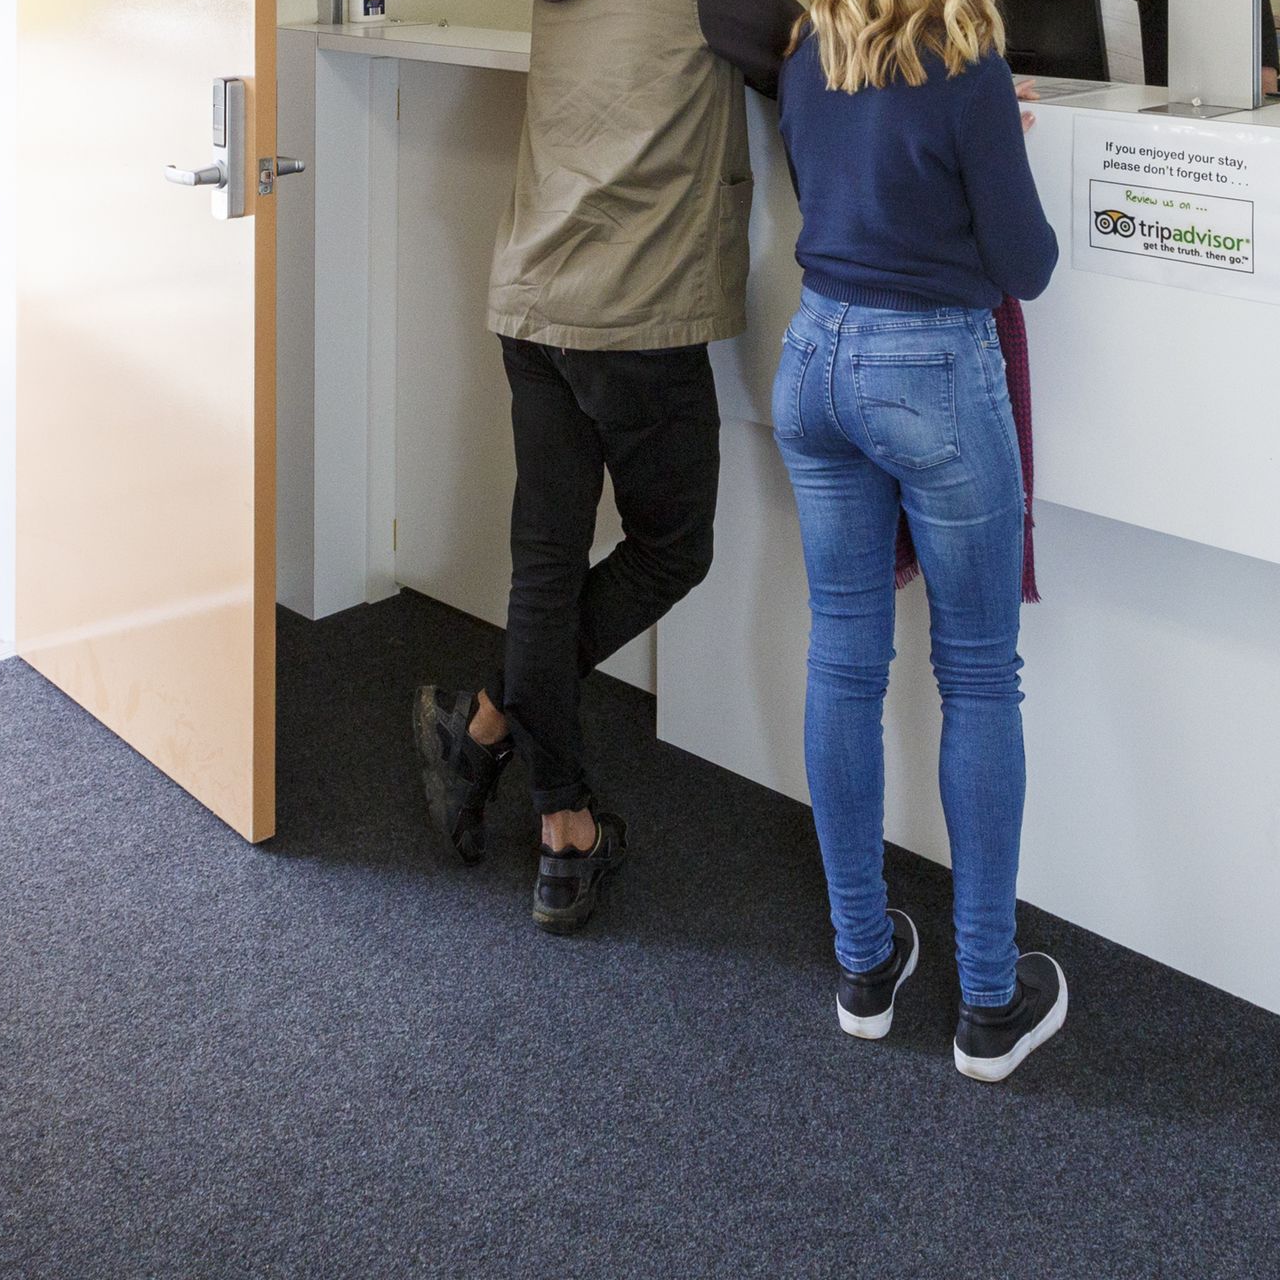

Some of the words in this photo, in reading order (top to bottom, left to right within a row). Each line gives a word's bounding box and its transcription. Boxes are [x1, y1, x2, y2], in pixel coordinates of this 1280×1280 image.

[1105, 141, 1113, 152] If
[1115, 145, 1136, 156] you
[1139, 147, 1185, 162] enjoyed
[1188, 152, 1215, 164] your
[1218, 155, 1248, 170] stay,
[1103, 158, 1141, 172] please
[1143, 164, 1174, 177] don't
[1177, 167, 1213, 182] forget
[1216, 173, 1228, 183] to
[1125, 189, 1158, 206] Review
[1162, 199, 1174, 208] us
[1179, 202, 1191, 210] on
[1139, 220, 1245, 252] tripadvisor
[1143, 241, 1158, 251] get
[1160, 243, 1175, 253] the
[1177, 246, 1203, 258] truth.
[1206, 250, 1226, 262] then
